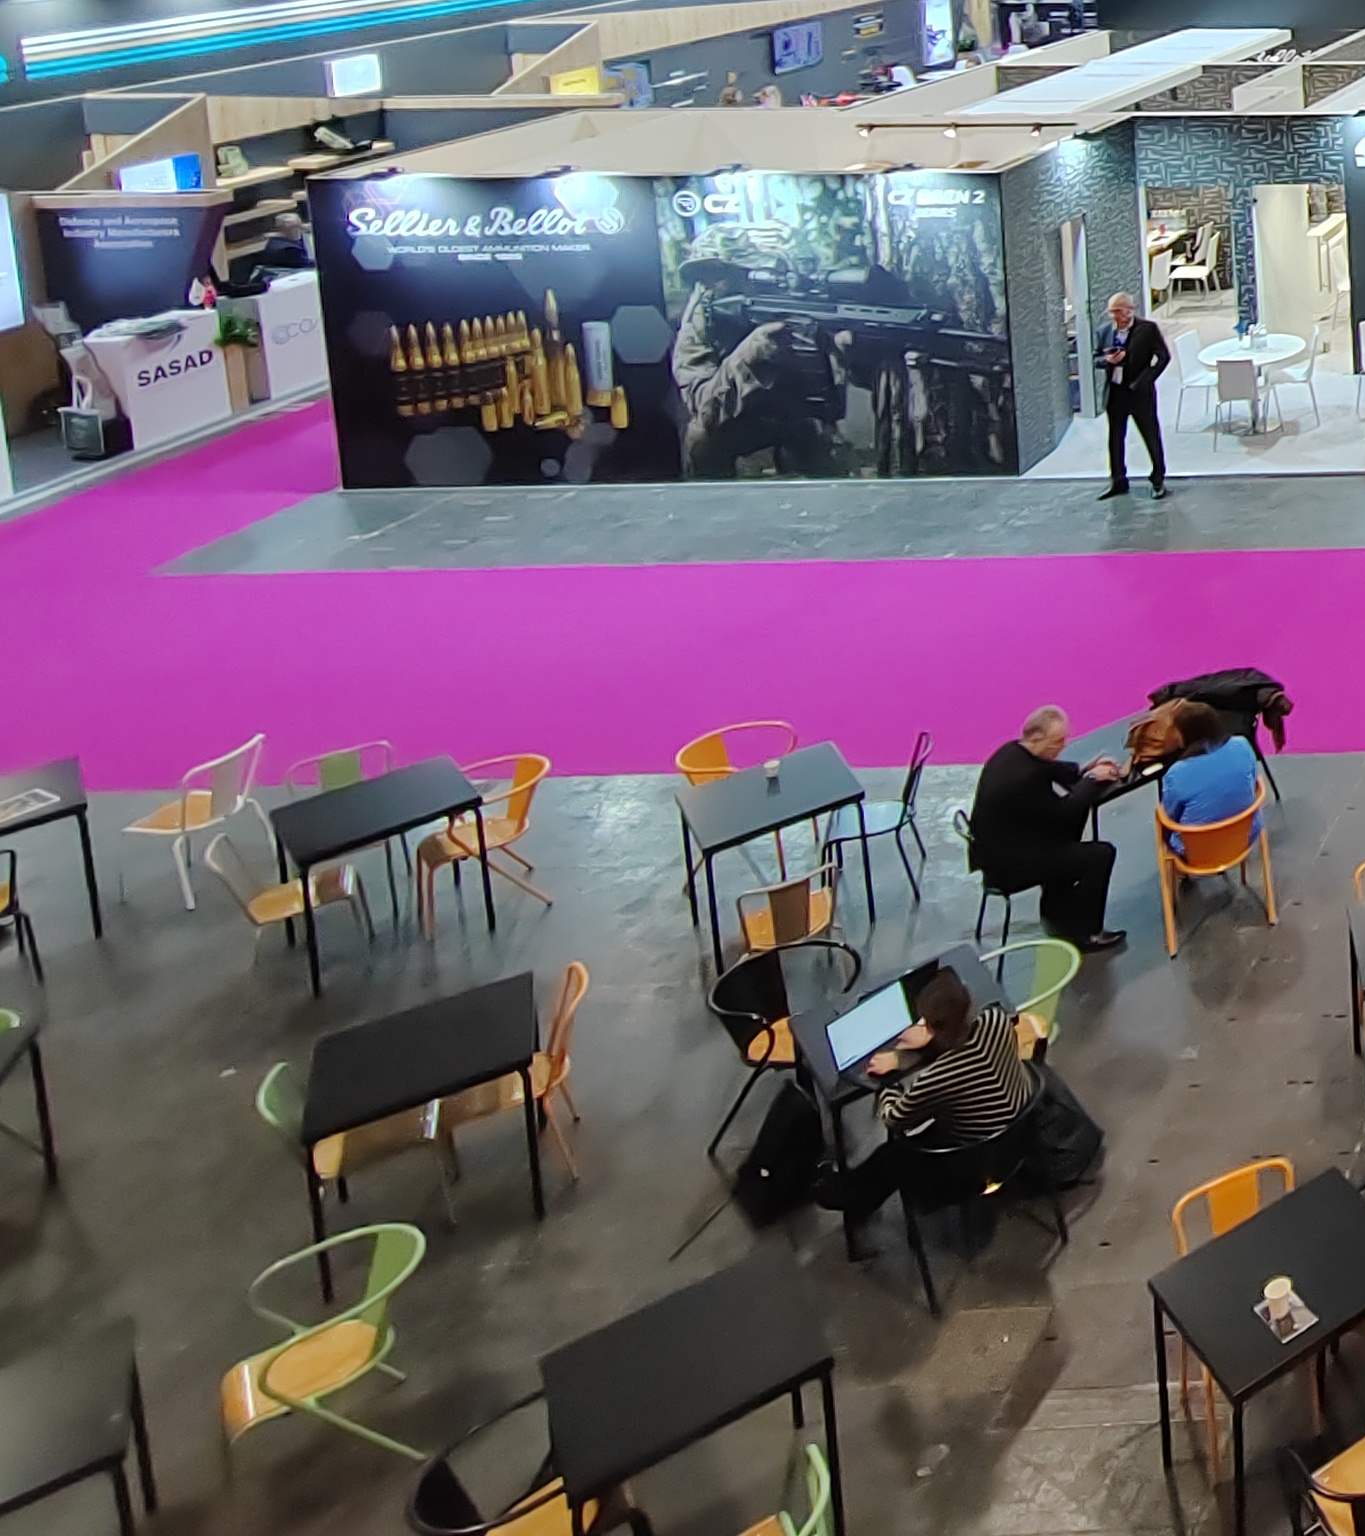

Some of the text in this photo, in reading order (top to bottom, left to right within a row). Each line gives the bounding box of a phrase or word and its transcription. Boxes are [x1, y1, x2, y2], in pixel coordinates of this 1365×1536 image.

[703, 192, 741, 214] CZ
[972, 189, 986, 204] 2
[347, 207, 590, 237] Sellier & Bellot
[138, 349, 214, 387] SASAD
